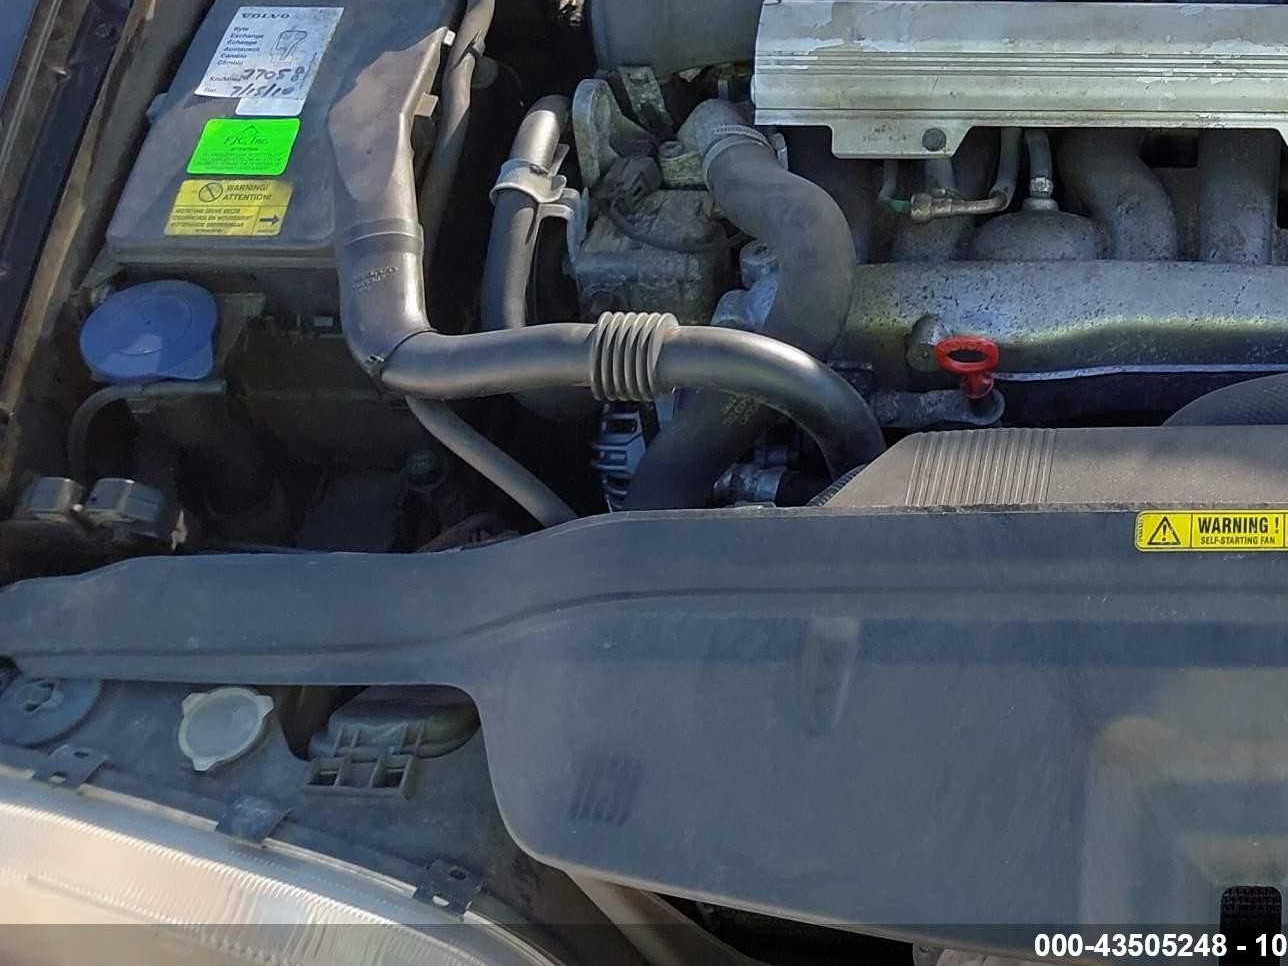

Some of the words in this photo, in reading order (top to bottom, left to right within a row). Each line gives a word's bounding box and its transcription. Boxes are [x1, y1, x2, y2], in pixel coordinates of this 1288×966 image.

[226, 184, 270, 192] WARNING!
[221, 194, 272, 202] ATTENTION!
[1198, 517, 1269, 534] WARNING
[1200, 536, 1259, 545] SELF-STARTING
[1260, 536, 1276, 545] FAN
